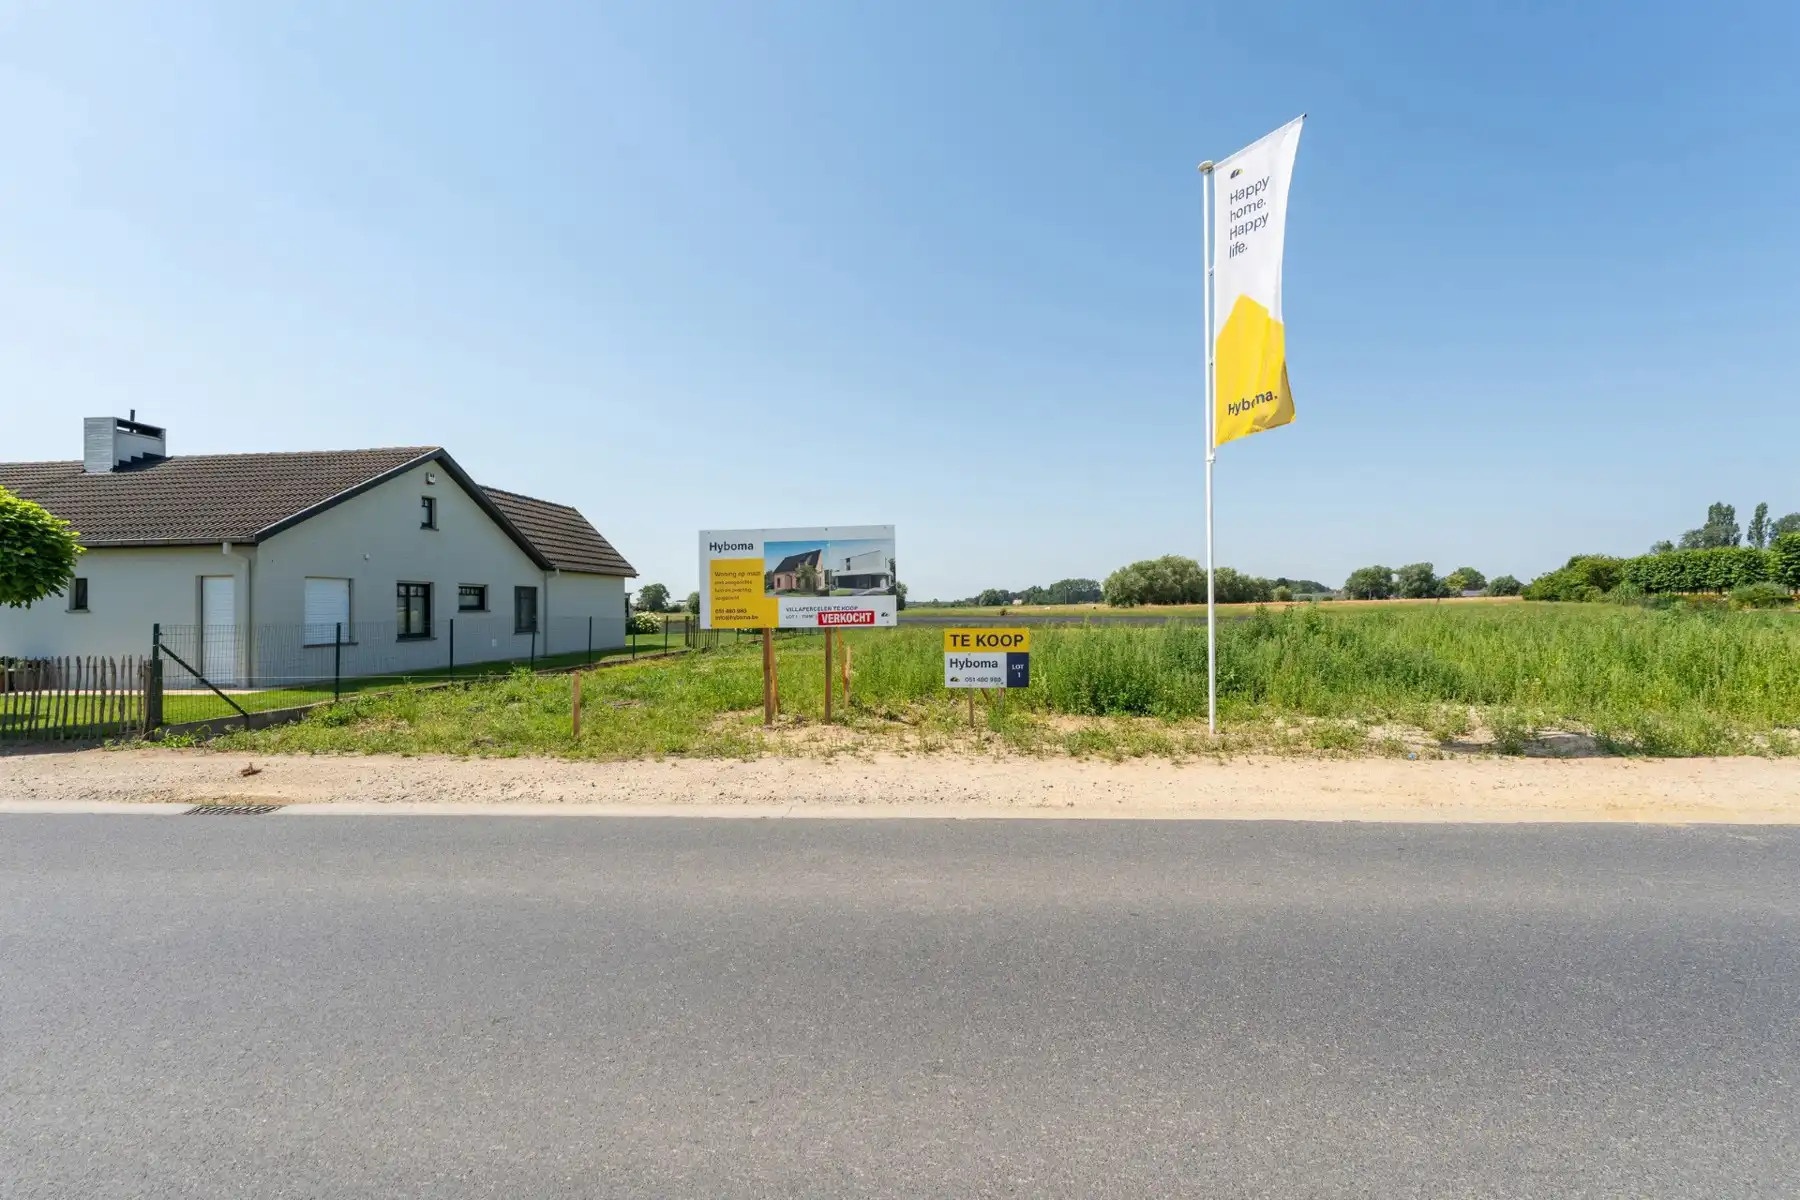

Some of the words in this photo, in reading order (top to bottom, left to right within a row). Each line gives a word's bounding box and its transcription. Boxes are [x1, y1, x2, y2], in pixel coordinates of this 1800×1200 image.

[1230, 176, 1270, 205] Happy
[1230, 198, 1266, 223] home.
[1229, 212, 1269, 240] Happy
[1229, 241, 1248, 259] life.
[709, 541, 754, 553] Hyboma
[821, 612, 872, 624] VERKOCHT
[949, 634, 970, 647] TE
[976, 634, 1024, 647] KOOP
[949, 658, 999, 670] Hyboma
